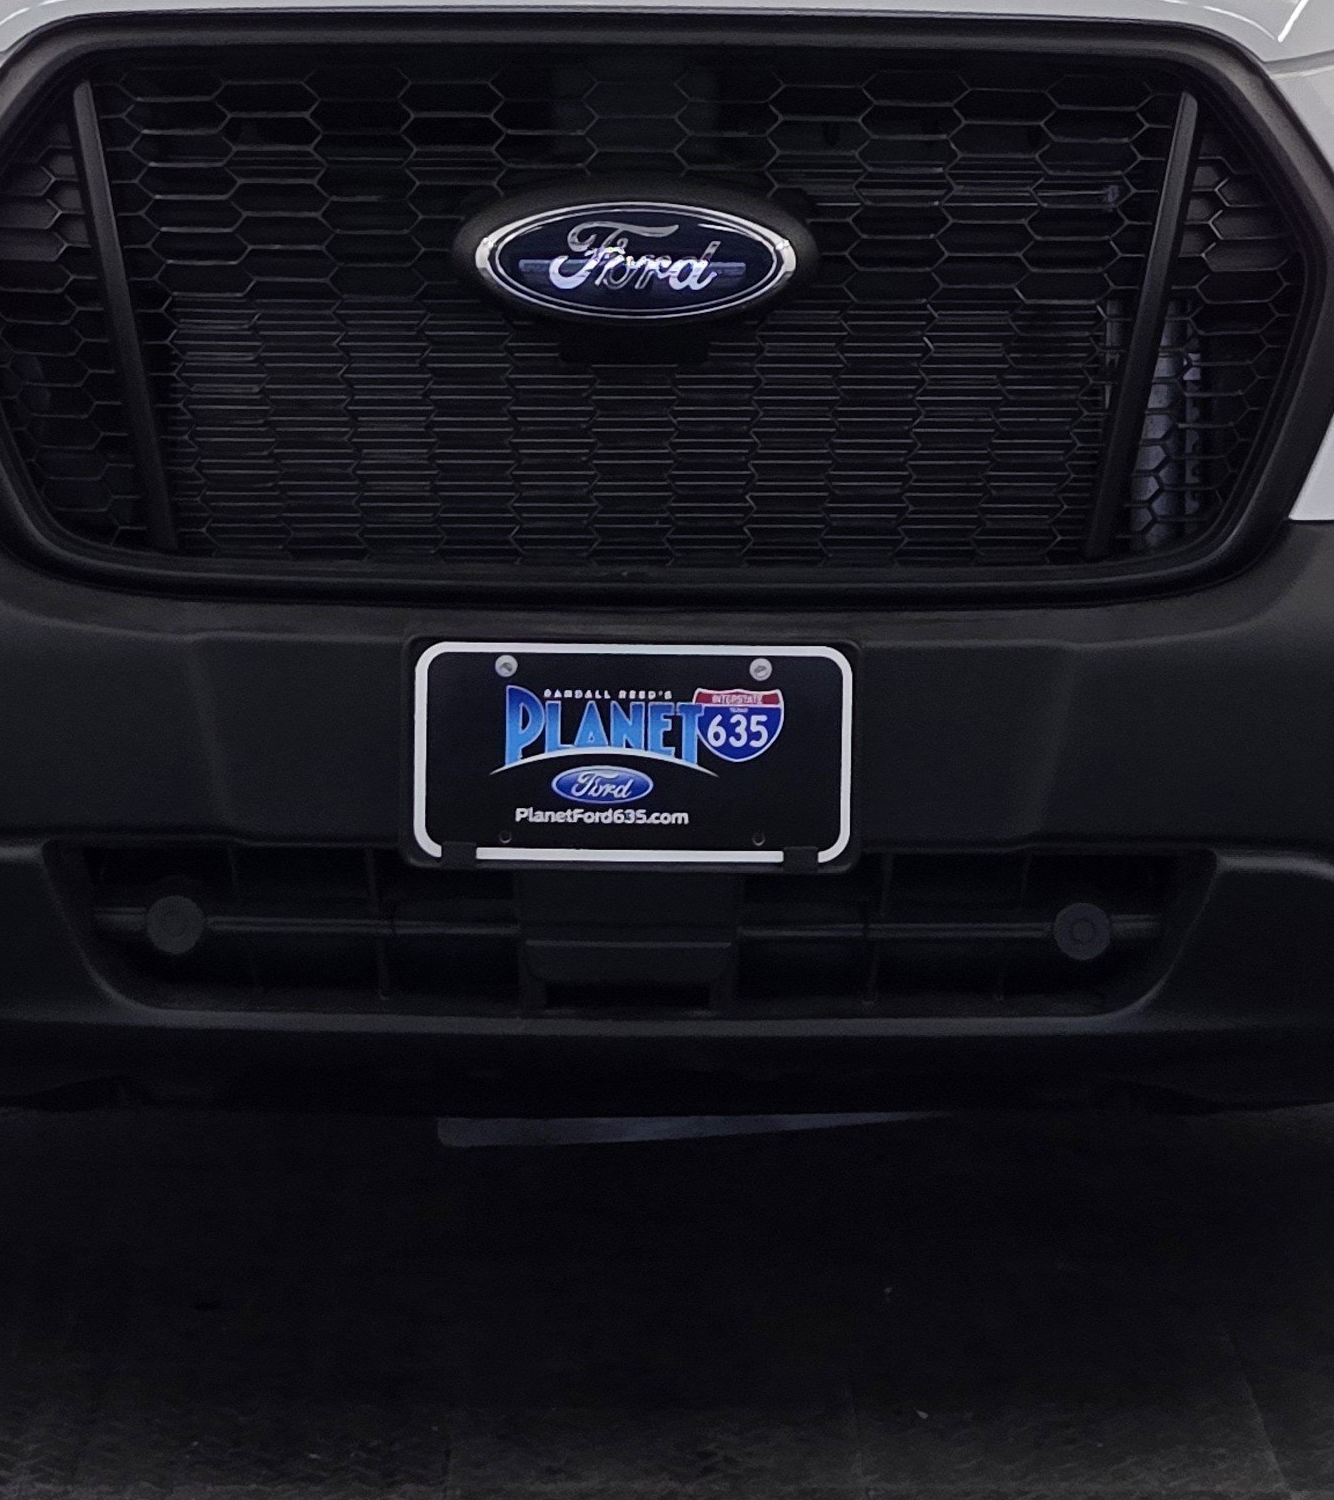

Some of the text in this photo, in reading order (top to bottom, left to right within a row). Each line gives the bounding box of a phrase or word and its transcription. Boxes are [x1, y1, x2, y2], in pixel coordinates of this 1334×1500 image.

[549, 220, 721, 291] Ford
[505, 684, 705, 766] PLANET
[707, 713, 769, 748] 635
[570, 770, 634, 799] Ford
[514, 806, 690, 826] PlanetFord635.com
